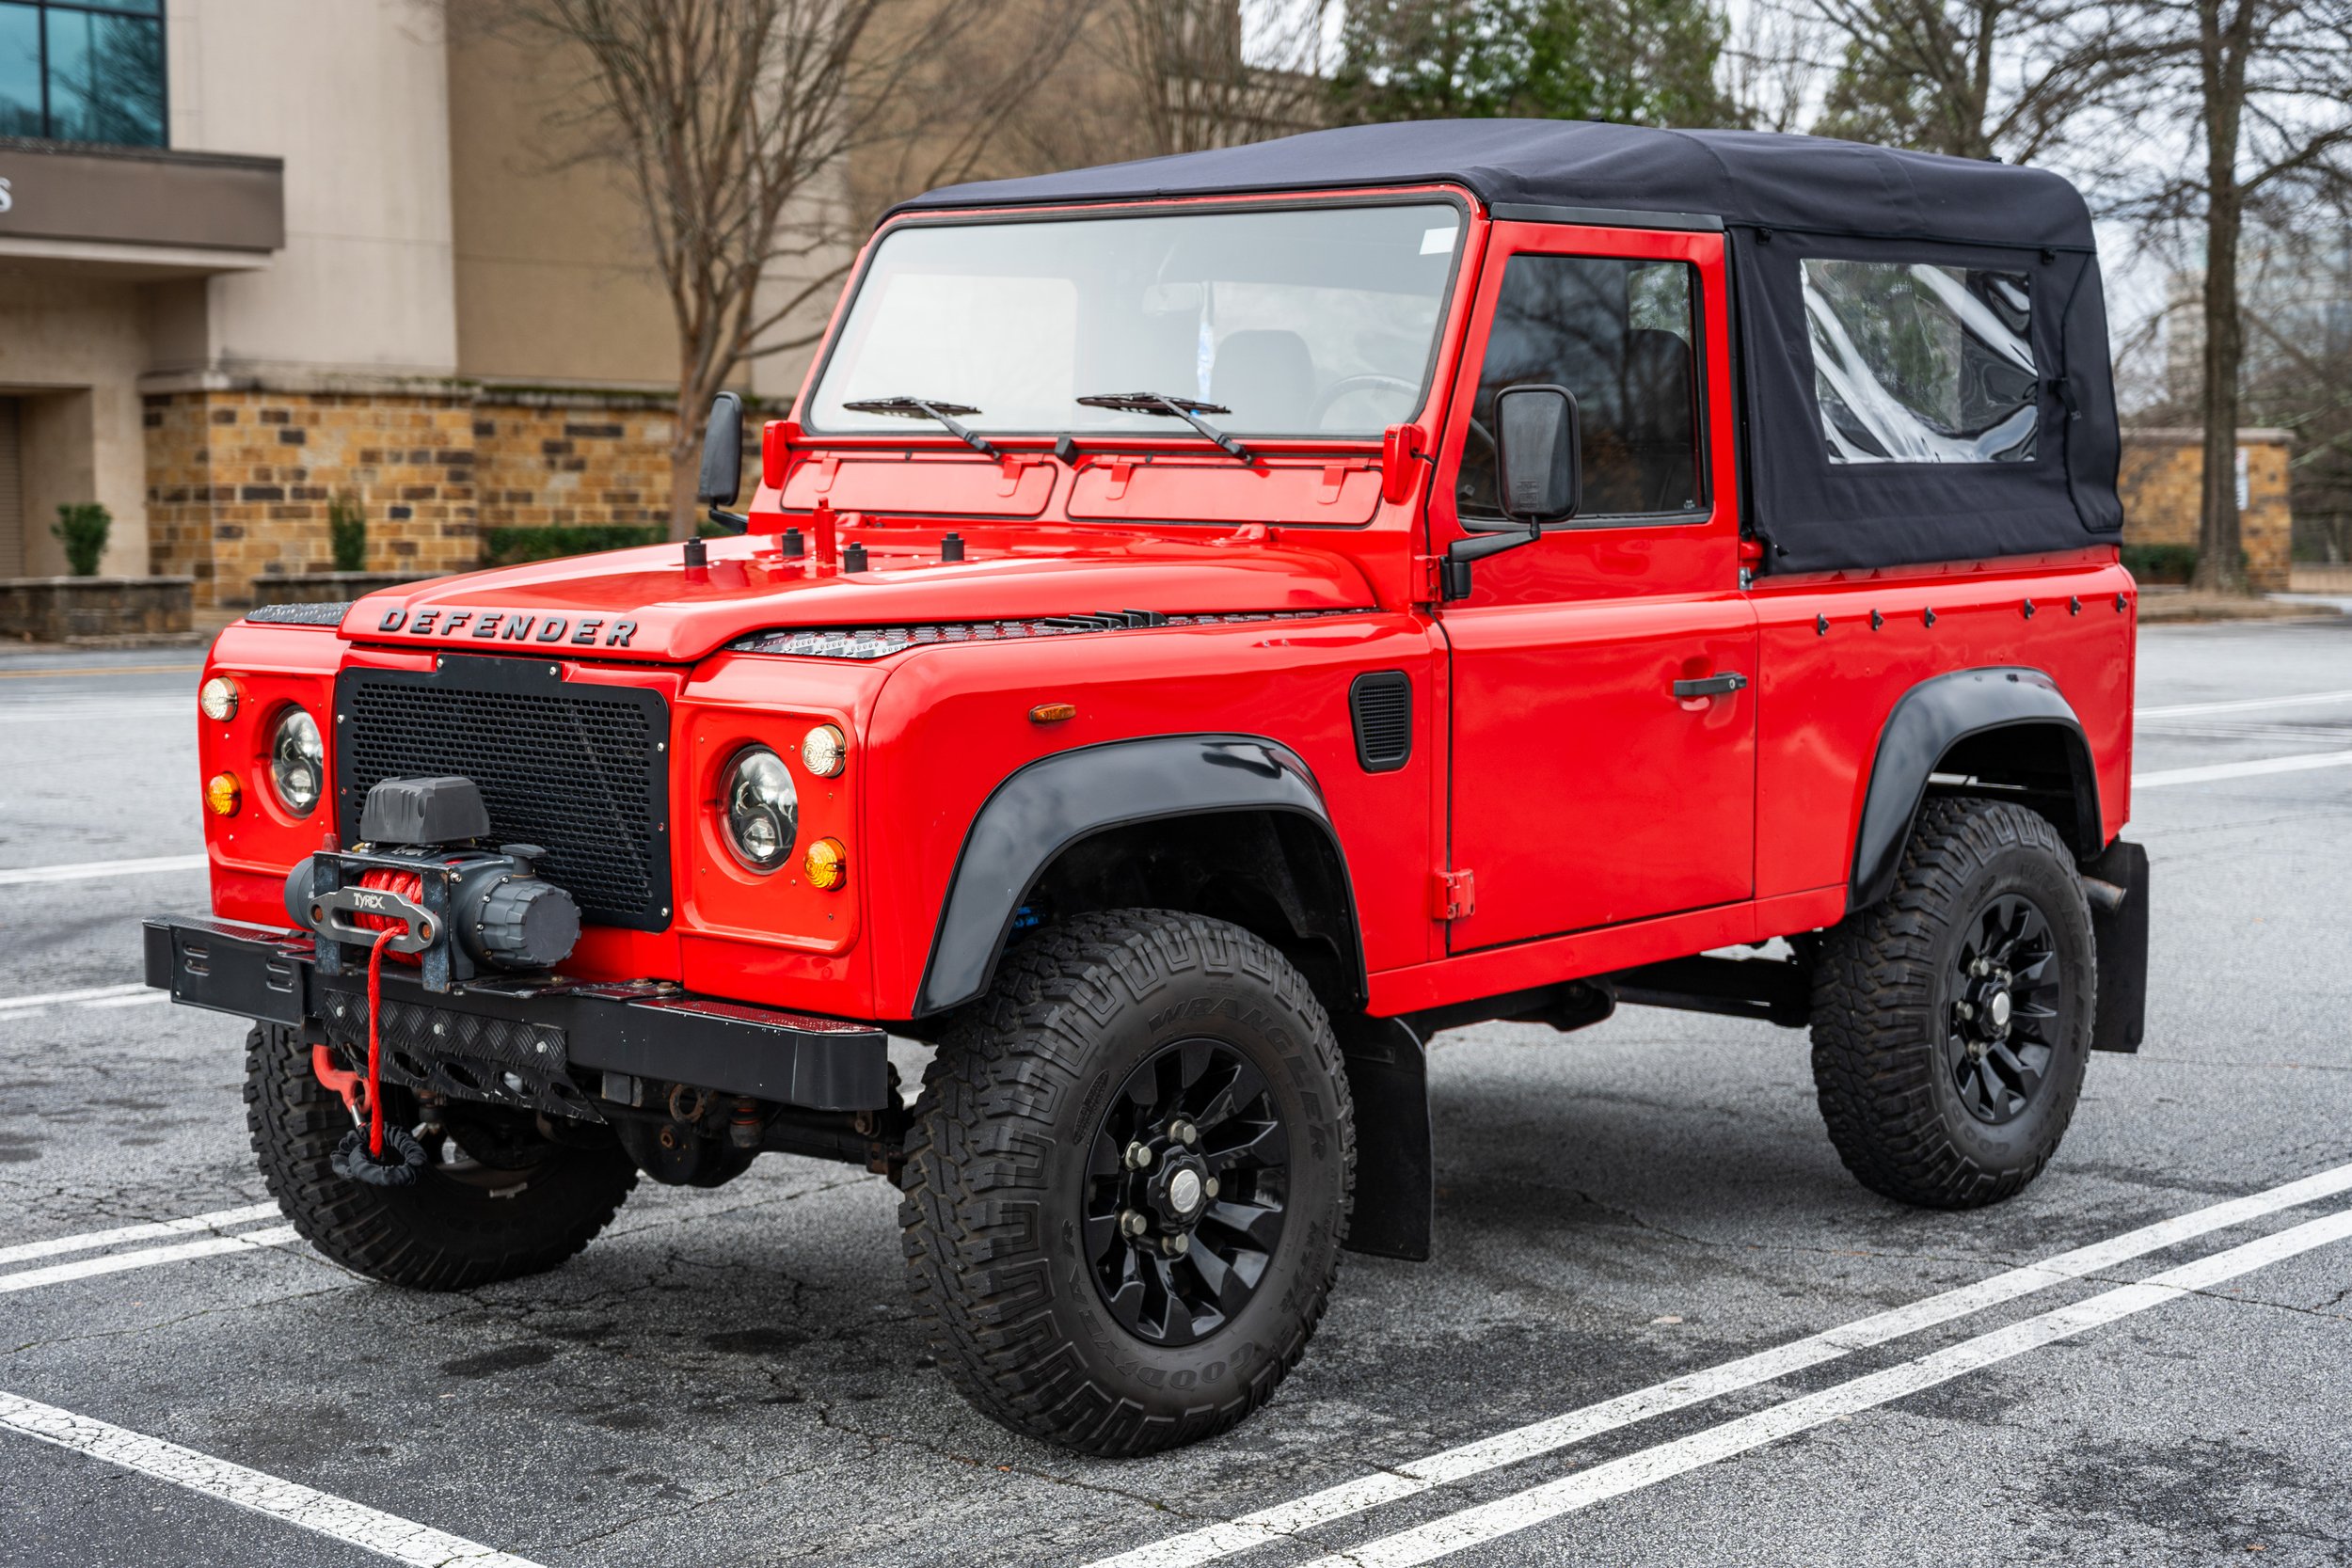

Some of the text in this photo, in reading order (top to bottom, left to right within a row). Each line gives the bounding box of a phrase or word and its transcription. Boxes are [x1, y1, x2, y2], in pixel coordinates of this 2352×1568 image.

[378, 607, 638, 648] DEFENDER
[354, 892, 385, 910] TYREX
[1148, 995, 1327, 1162] WRANGLER
[1061, 1218, 1256, 1390] GOODYEAR
